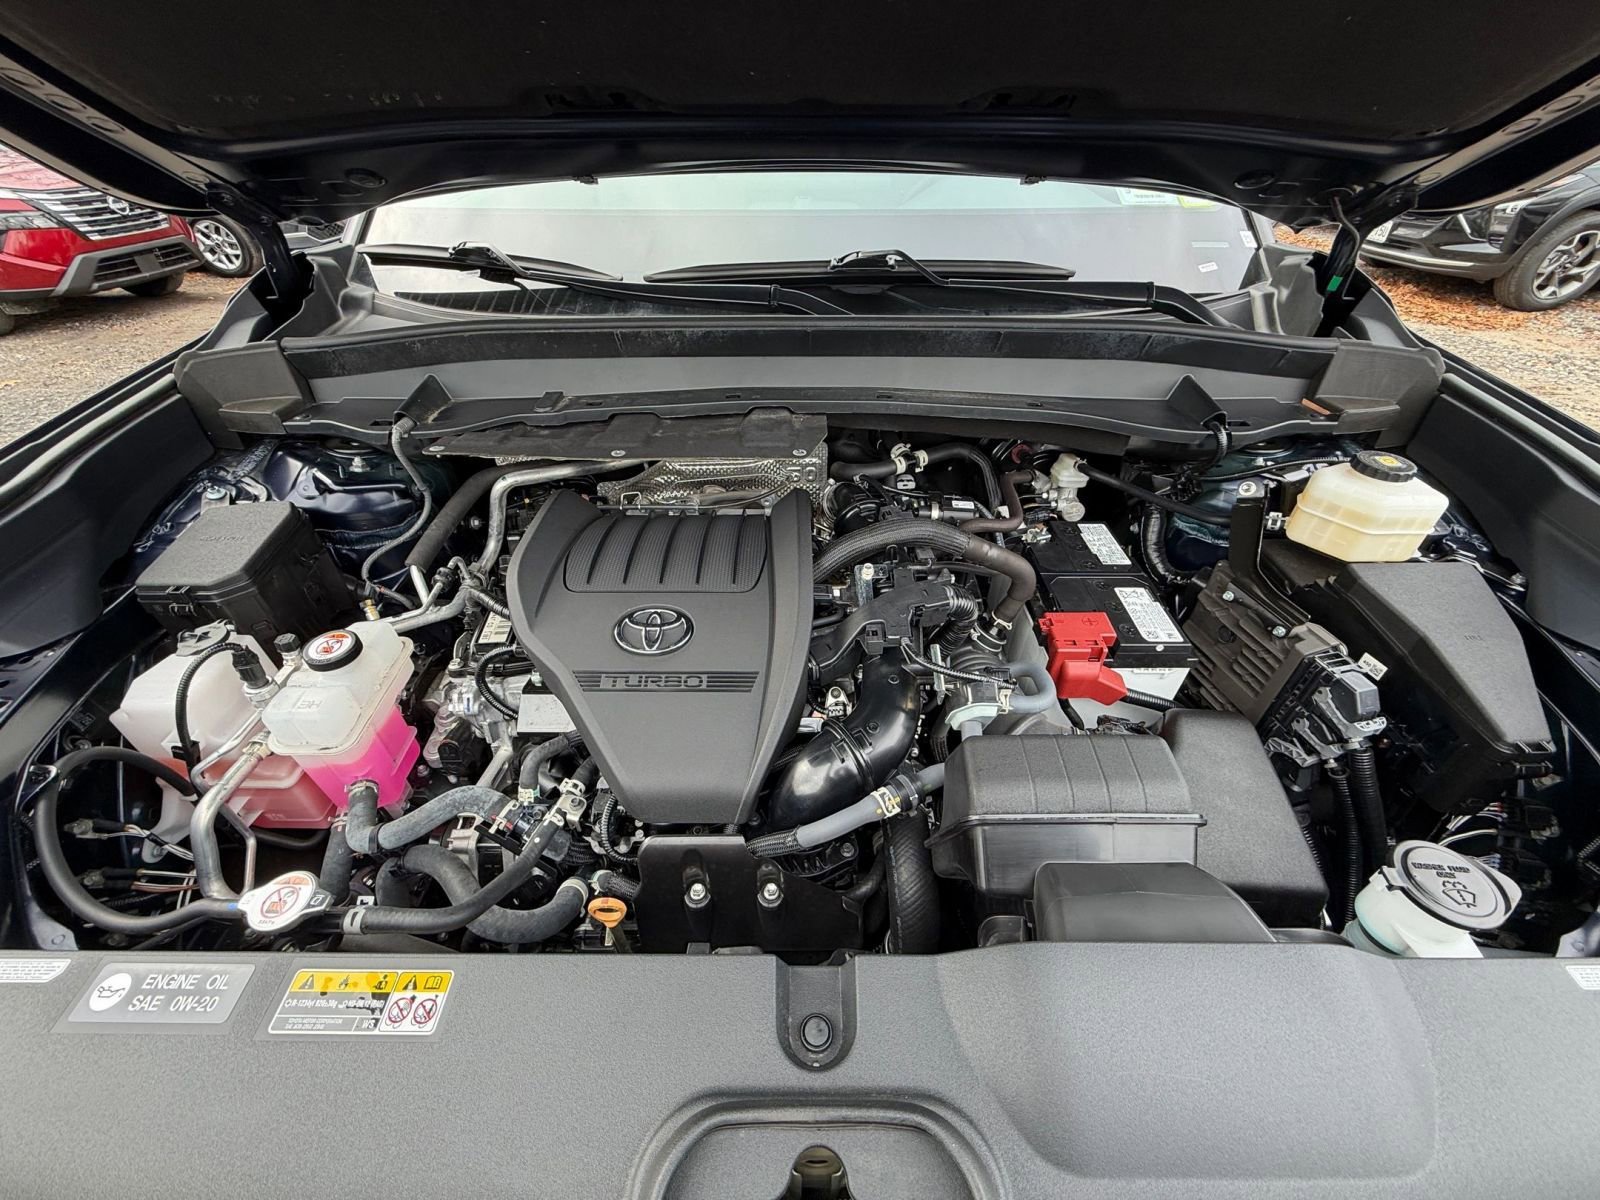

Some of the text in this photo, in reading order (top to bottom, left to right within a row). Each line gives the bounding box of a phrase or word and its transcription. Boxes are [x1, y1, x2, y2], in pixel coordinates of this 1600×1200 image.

[604, 675, 704, 688] TURBO
[141, 974, 229, 990] ENGINE OIL
[128, 995, 220, 1012] SAE 0W-20
